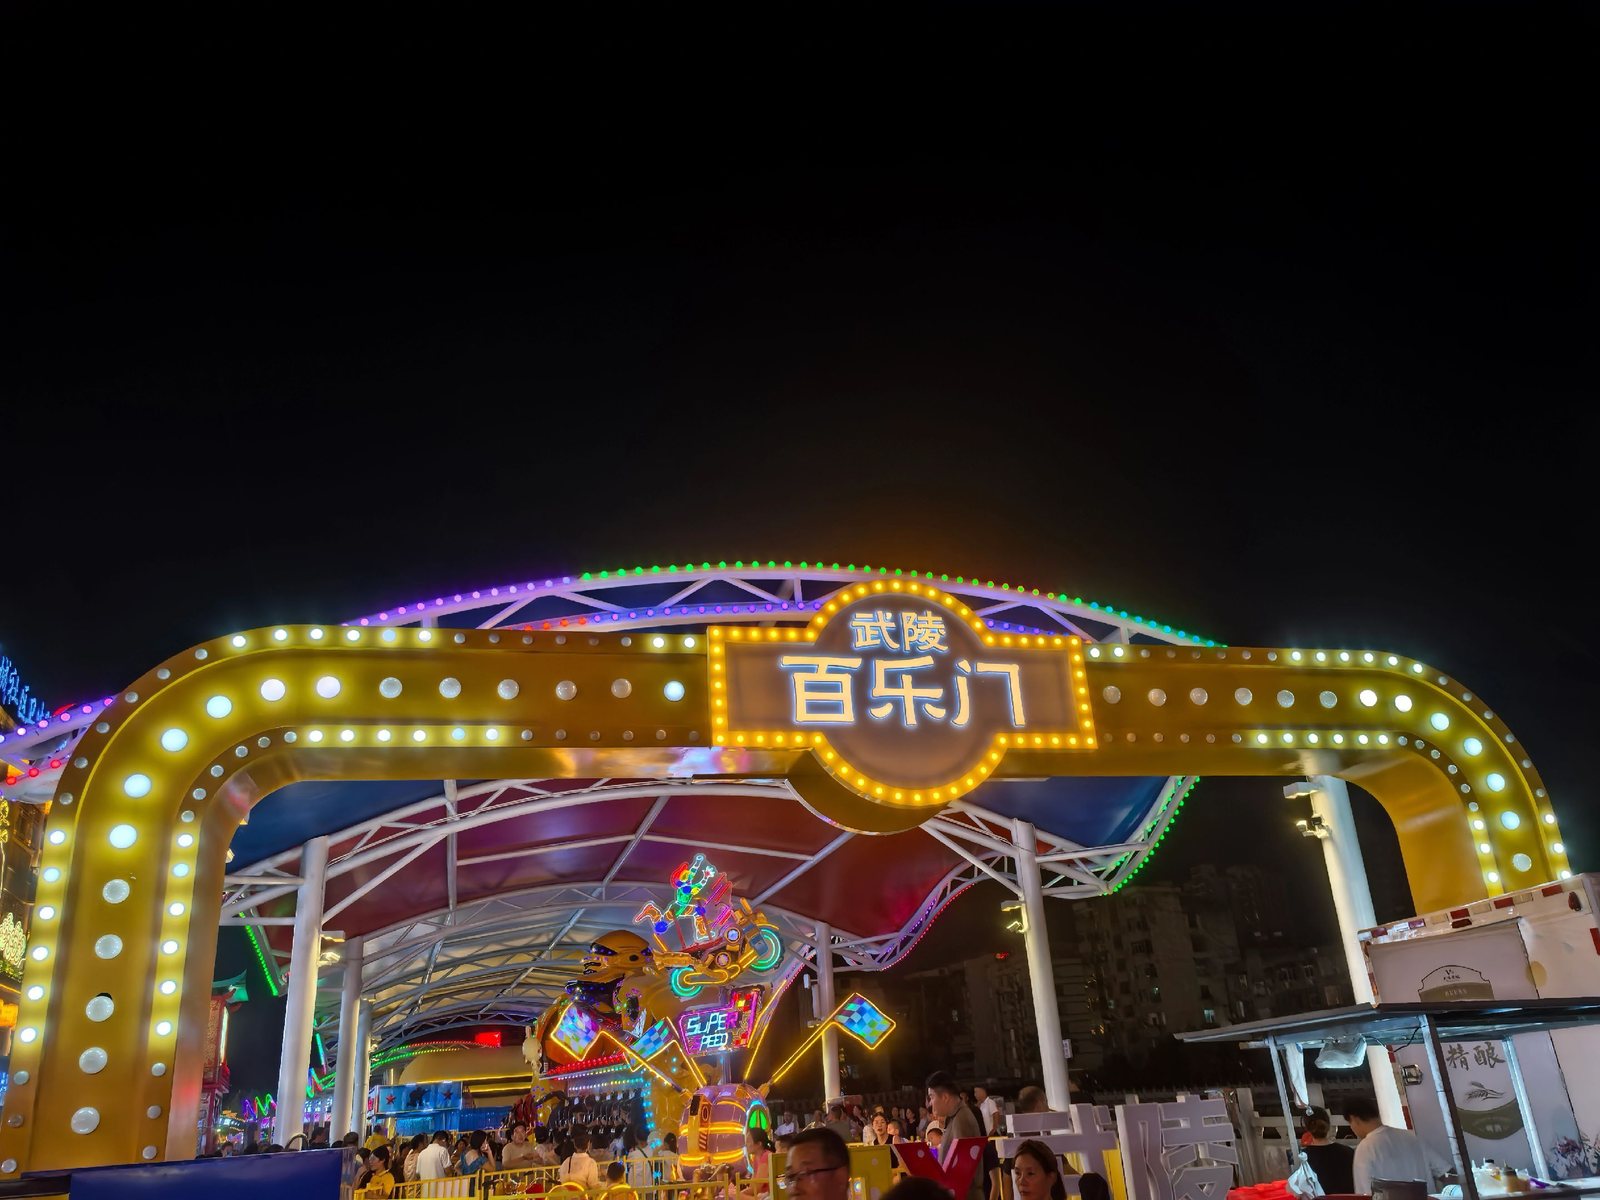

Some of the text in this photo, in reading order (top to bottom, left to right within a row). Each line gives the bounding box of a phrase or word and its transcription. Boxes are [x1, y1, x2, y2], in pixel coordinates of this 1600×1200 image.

[849, 610, 949, 652] 武陵
[779, 655, 1026, 728] 百乐门
[685, 1011, 739, 1037] SUPER
[1446, 1041, 1506, 1071] 精酿
